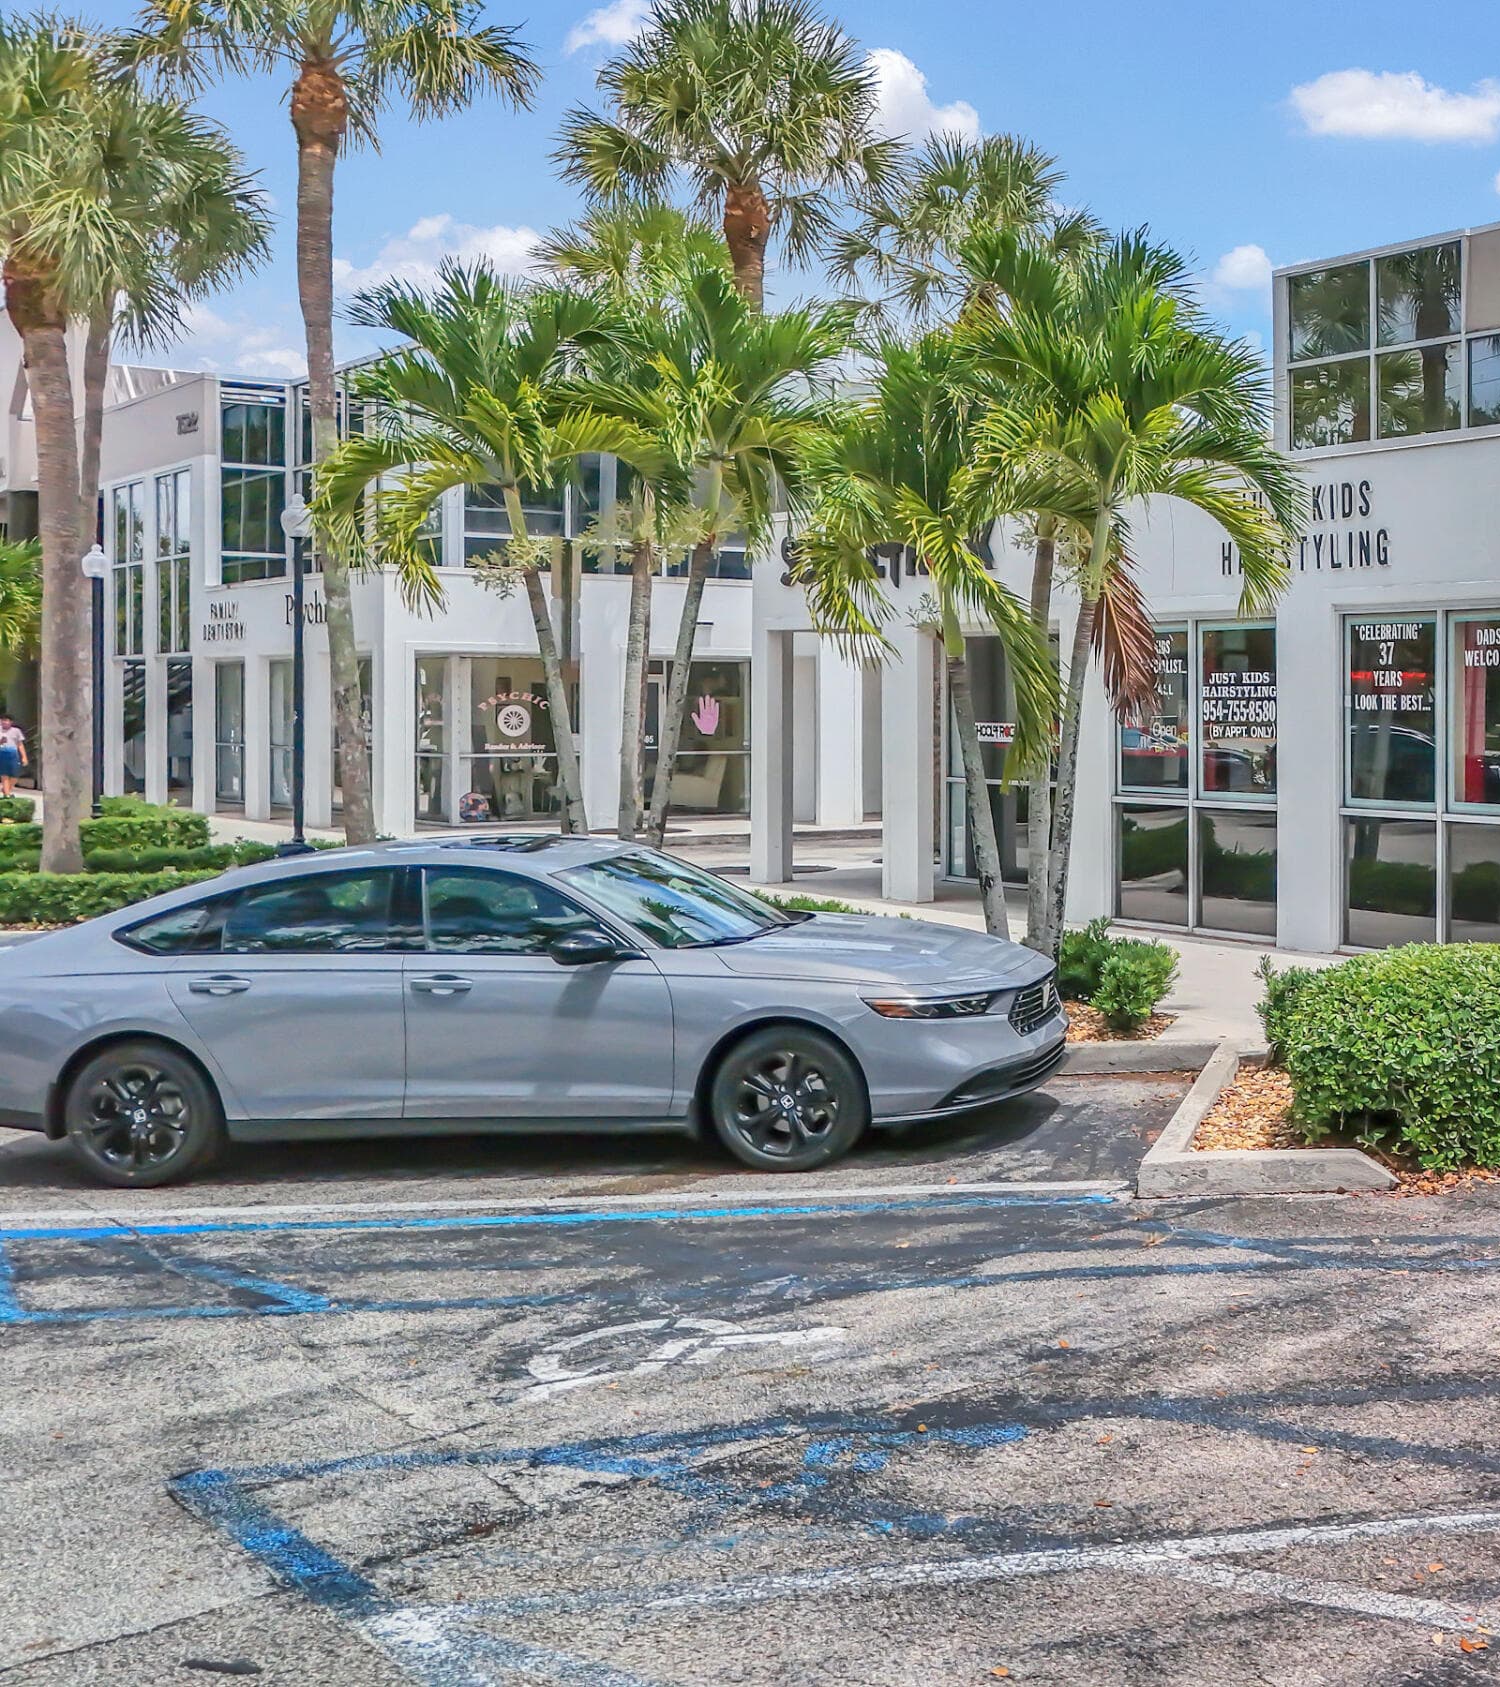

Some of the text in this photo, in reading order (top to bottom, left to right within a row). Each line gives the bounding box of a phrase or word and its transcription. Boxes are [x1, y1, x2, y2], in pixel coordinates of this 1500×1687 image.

[1312, 479, 1372, 521] KIDS
[1378, 642, 1395, 665] 37
[1209, 672, 1270, 684] JUST KIDS
[1373, 670, 1402, 687] YEARS
[1202, 685, 1277, 698] HAIRSTYLING
[1355, 694, 1377, 711] LOOK
[1379, 693, 1397, 711] THE
[1203, 700, 1276, 722] 954-755-8580
[1209, 723, 1276, 740] (BY APPT. ONLY)
